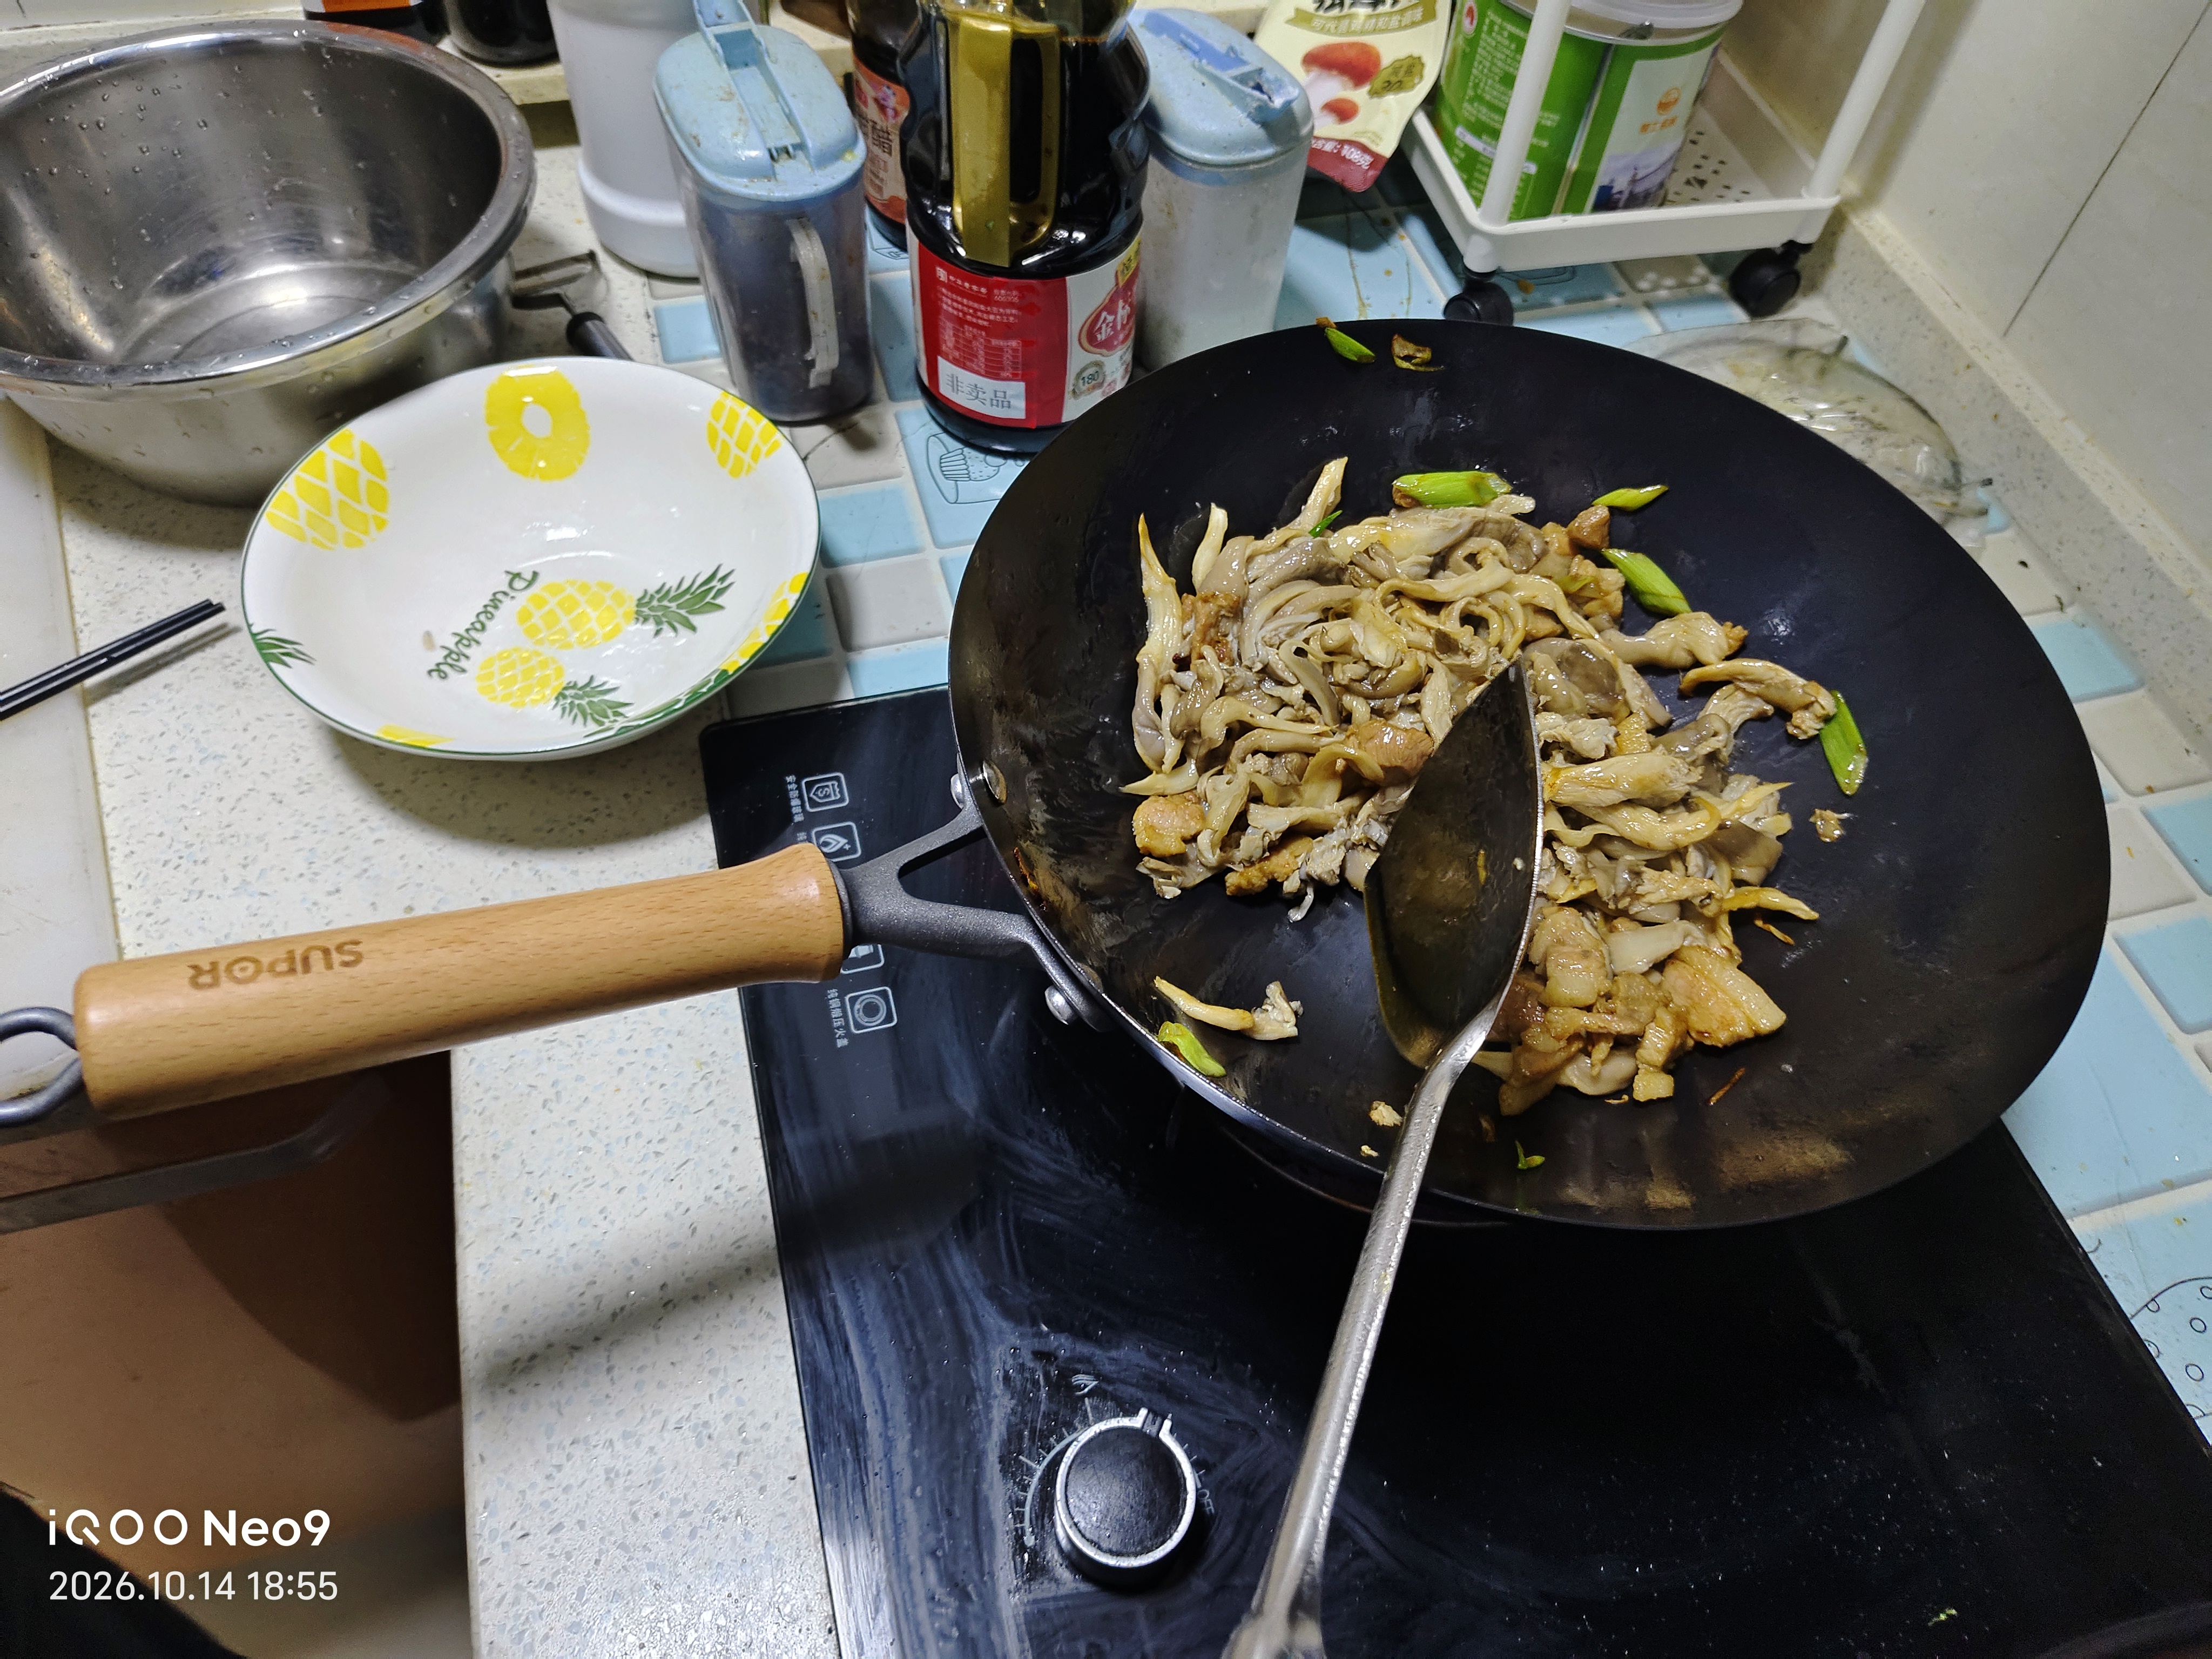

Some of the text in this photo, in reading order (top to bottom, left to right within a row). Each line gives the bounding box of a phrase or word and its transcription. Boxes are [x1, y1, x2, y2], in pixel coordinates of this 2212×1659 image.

[946, 373, 1011, 409] 非卖品
[1081, 370, 1100, 387] 180
[427, 570, 539, 680] Pineapple
[187, 939, 363, 990] SUPOR
[1197, 1489, 1215, 1515] OFF
